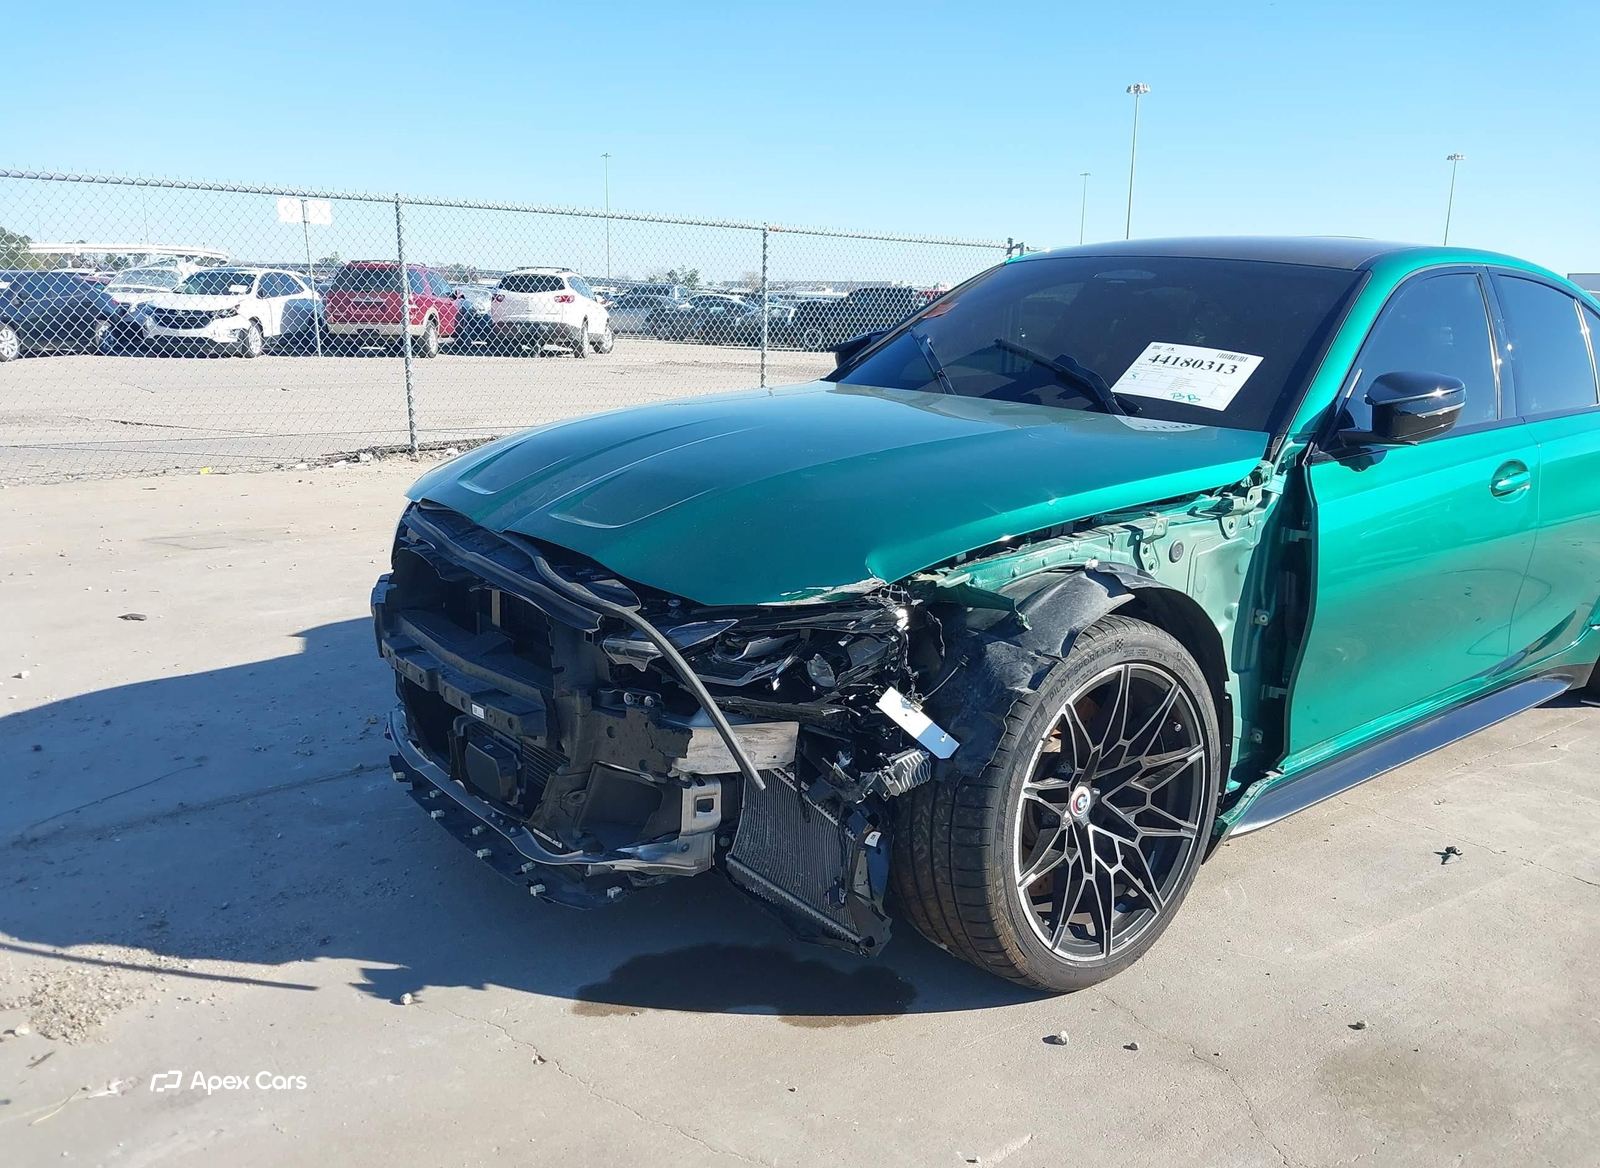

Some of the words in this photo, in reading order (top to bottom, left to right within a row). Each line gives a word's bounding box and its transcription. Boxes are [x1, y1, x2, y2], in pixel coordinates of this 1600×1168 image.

[1148, 353, 1238, 375] 44180313
[1049, 673, 1072, 702] PILOT
[1073, 650, 1102, 676] SPORT
